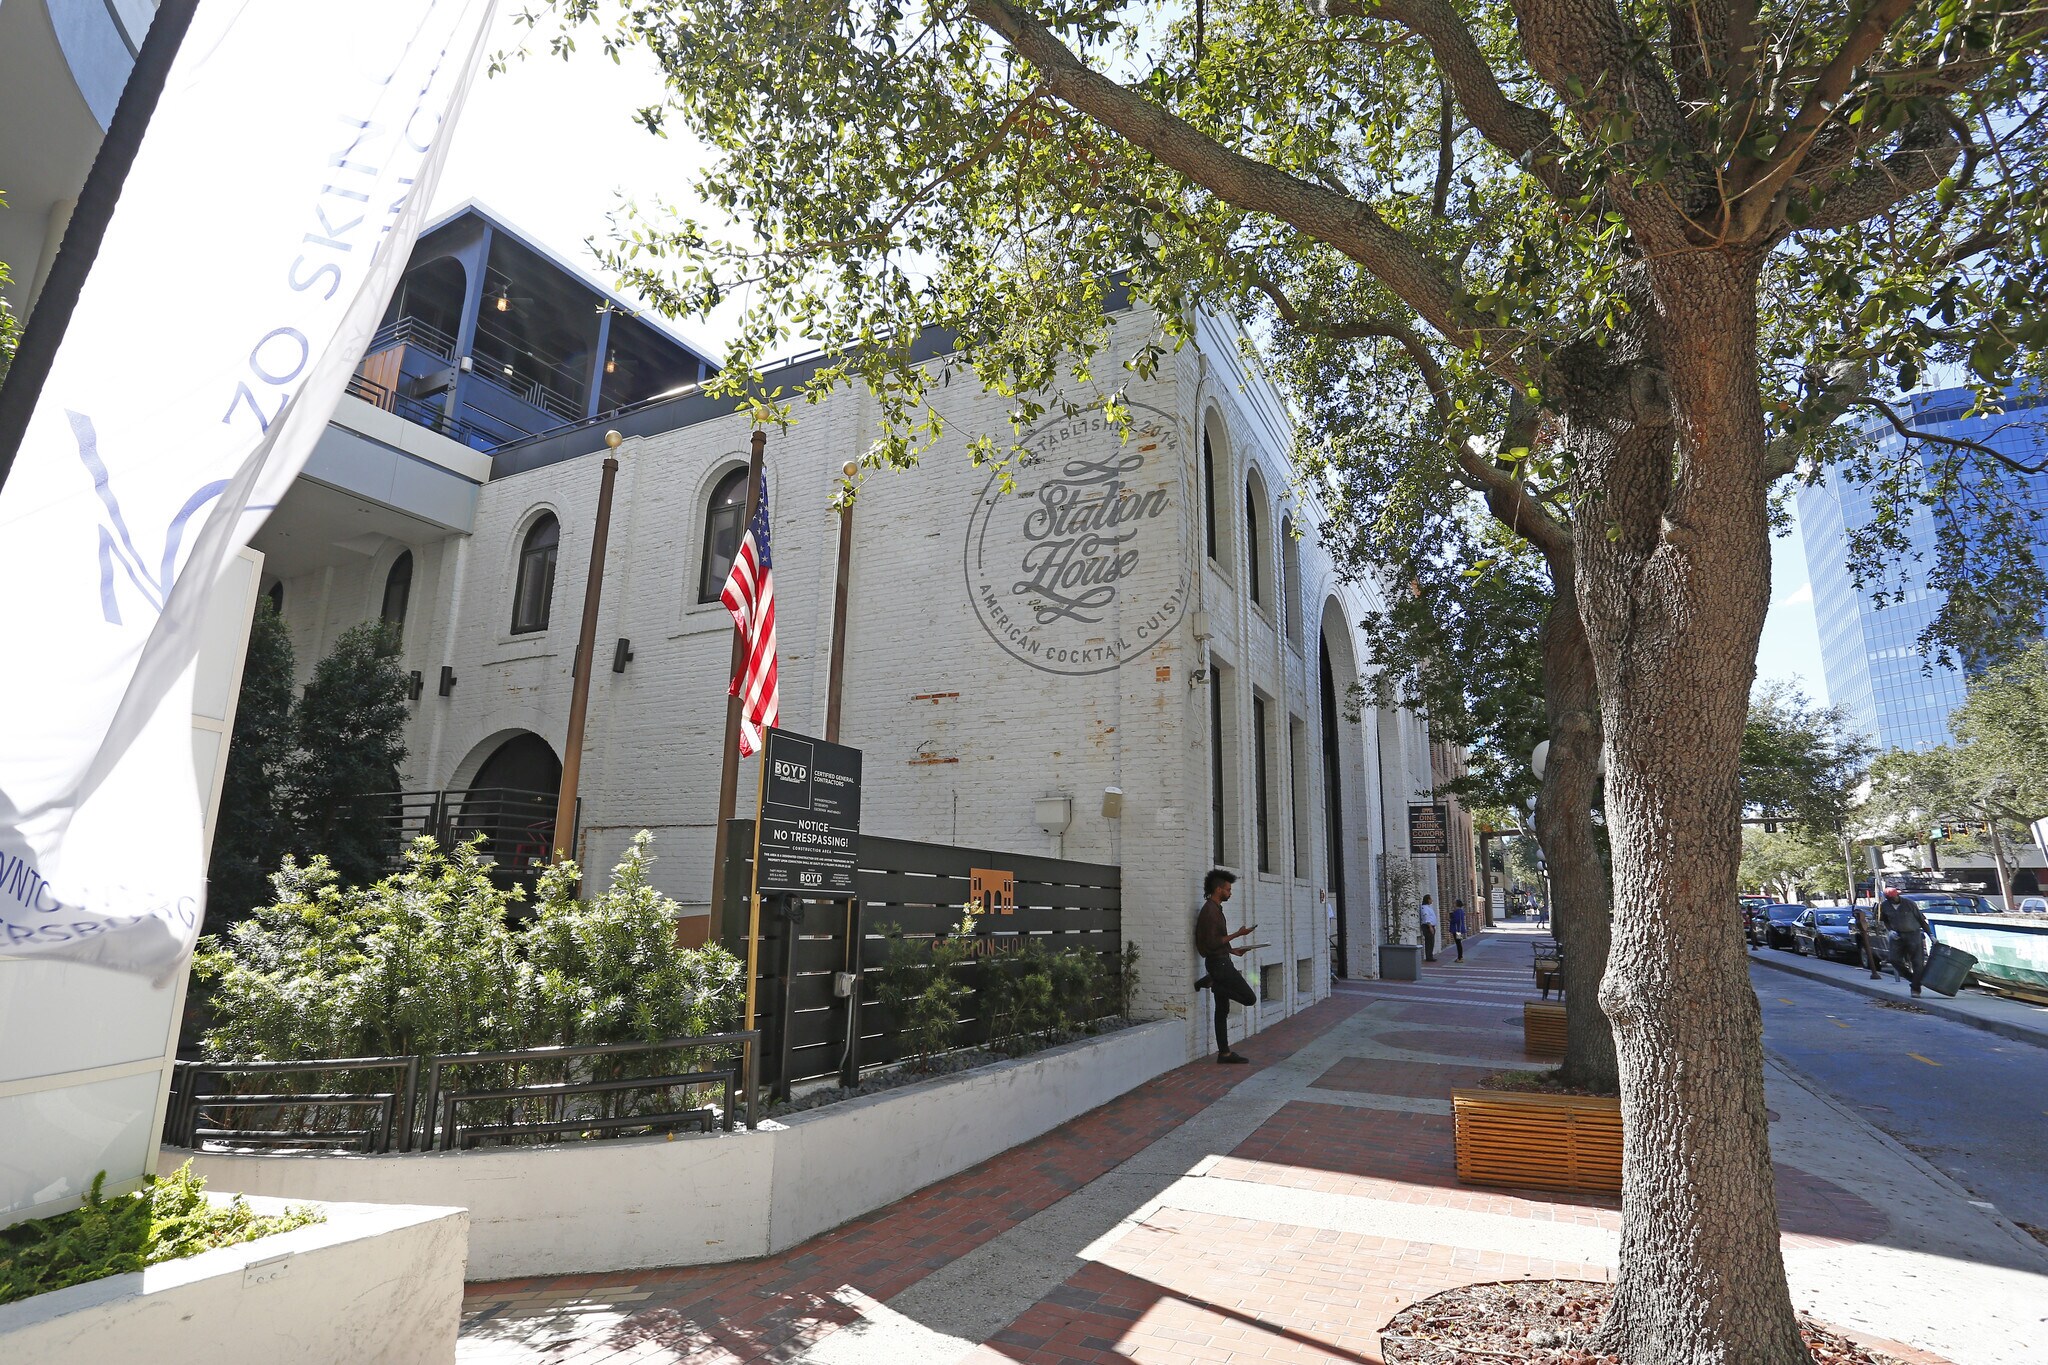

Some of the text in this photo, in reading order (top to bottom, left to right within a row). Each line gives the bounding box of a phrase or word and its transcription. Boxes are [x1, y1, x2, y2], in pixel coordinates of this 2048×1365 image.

[222, 114, 386, 436] ZO SKIN
[1023, 478, 1170, 541] Station
[1013, 529, 1140, 597] House
[979, 584, 1041, 655] AMERICAN
[1046, 637, 1132, 664] COCKTAIL
[774, 761, 807, 780] BOYD
[814, 770, 854, 784] CERTIFIED GENERAL
[814, 776, 844, 787] CONTRACTORS
[798, 819, 829, 833] NOTICE
[773, 830, 849, 847] NO TRESPASSING!
[792, 845, 821, 853] CONSTRUCTION
[800, 873, 822, 883] BOYD
